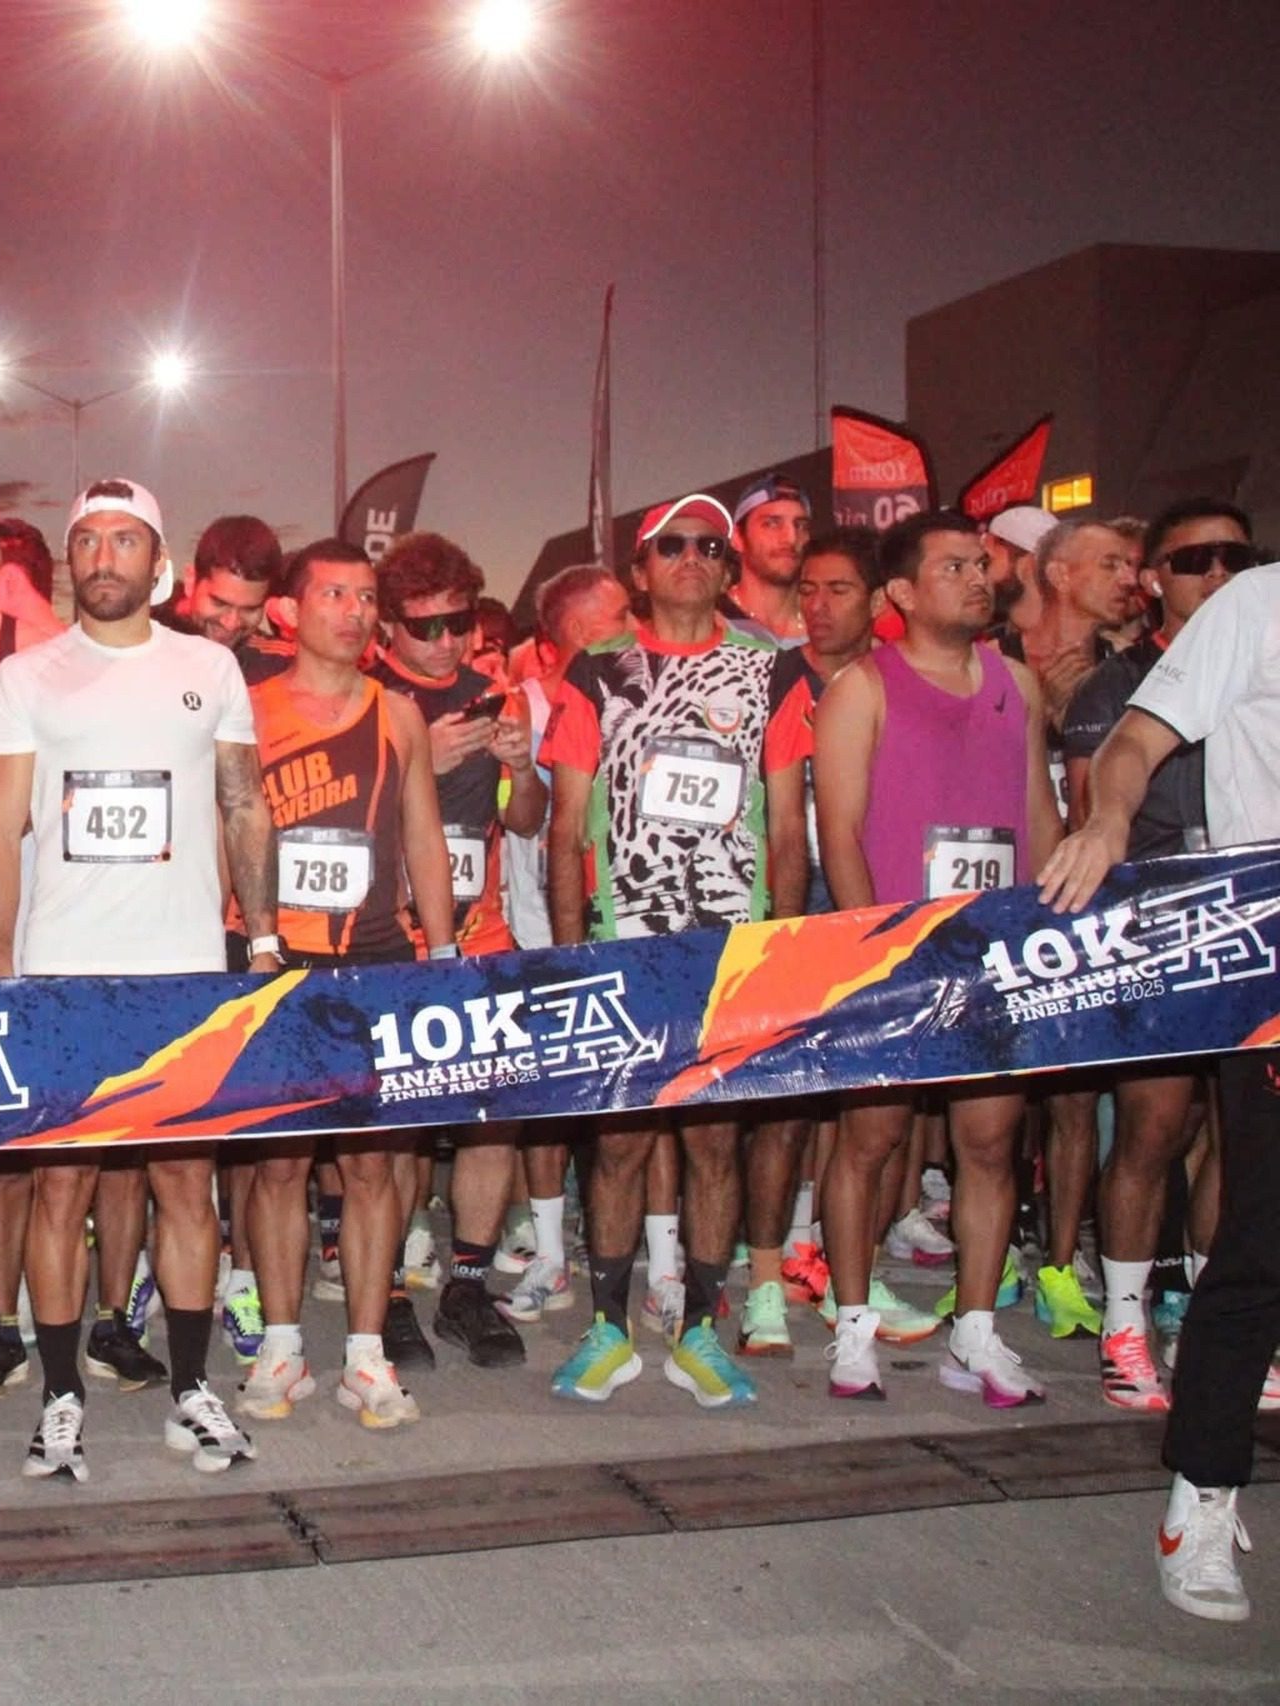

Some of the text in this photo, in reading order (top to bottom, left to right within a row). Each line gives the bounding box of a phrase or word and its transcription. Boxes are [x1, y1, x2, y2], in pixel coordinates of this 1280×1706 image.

[665, 772, 719, 808] 752
[86, 805, 147, 840] 432
[293, 859, 349, 893] 738
[450, 853, 474, 882] 24
[951, 858, 1001, 890] 219
[981, 907, 1151, 993] 10K
[1004, 961, 1161, 1011] ANÁHUAC
[1008, 978, 1166, 1024] FINBE ABC 2025
[370, 990, 533, 1070] 10K
[379, 1052, 539, 1093] ANÁHUAC
[379, 1070, 541, 1106] FINBE ABC 2025
